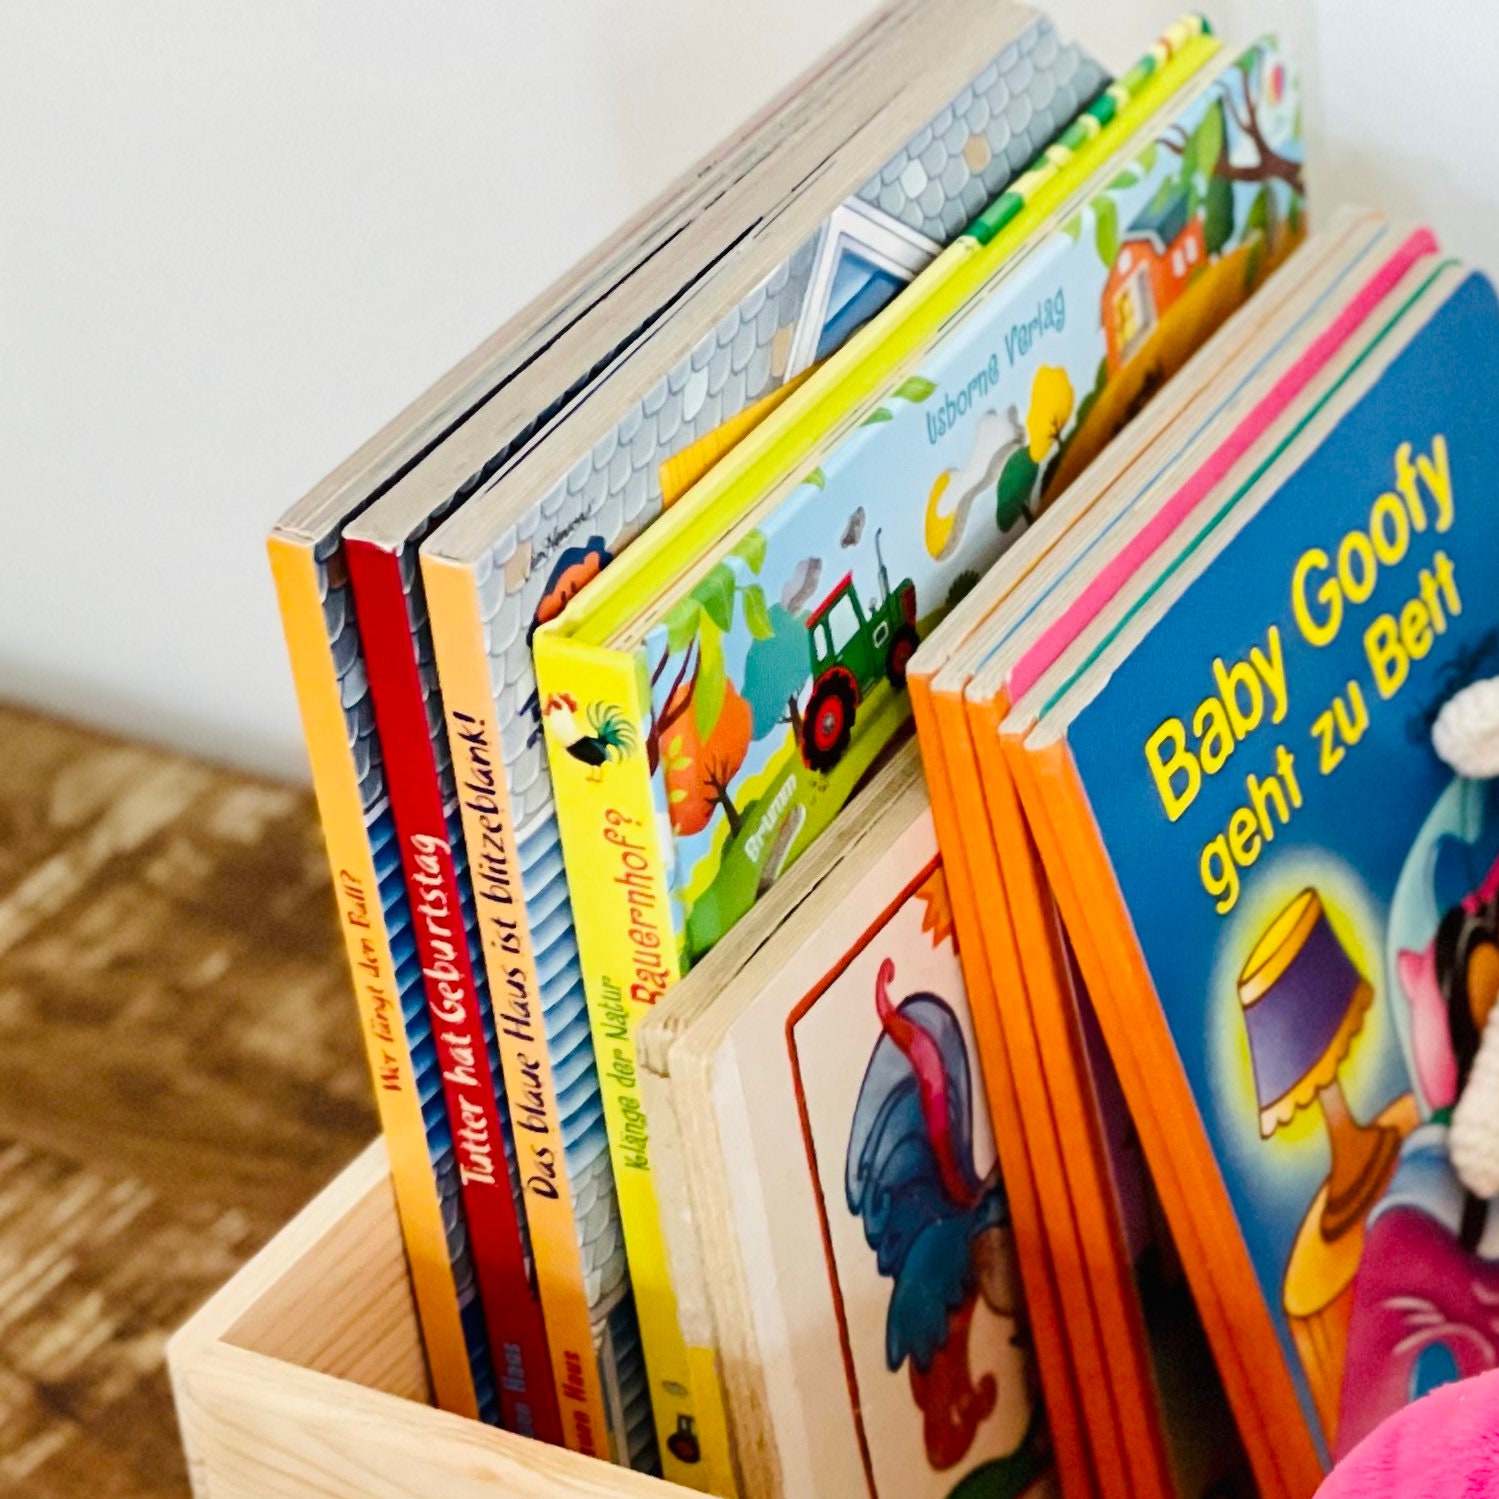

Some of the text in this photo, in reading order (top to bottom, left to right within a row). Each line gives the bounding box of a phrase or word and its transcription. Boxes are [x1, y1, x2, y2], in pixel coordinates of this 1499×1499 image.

[926, 286, 1066, 445] Usborne Verlag
[1144, 433, 1455, 823] Baby Goofy
[1199, 550, 1462, 915] geht zu Bett
[340, 869, 370, 929] Ball?
[358, 937, 380, 978] den
[410, 833, 498, 1186] Tutter hat Geburtstag
[452, 710, 559, 1200] Das blaue Haus ist blitzeblank!
[597, 975, 650, 1171] Klänge der Natur
